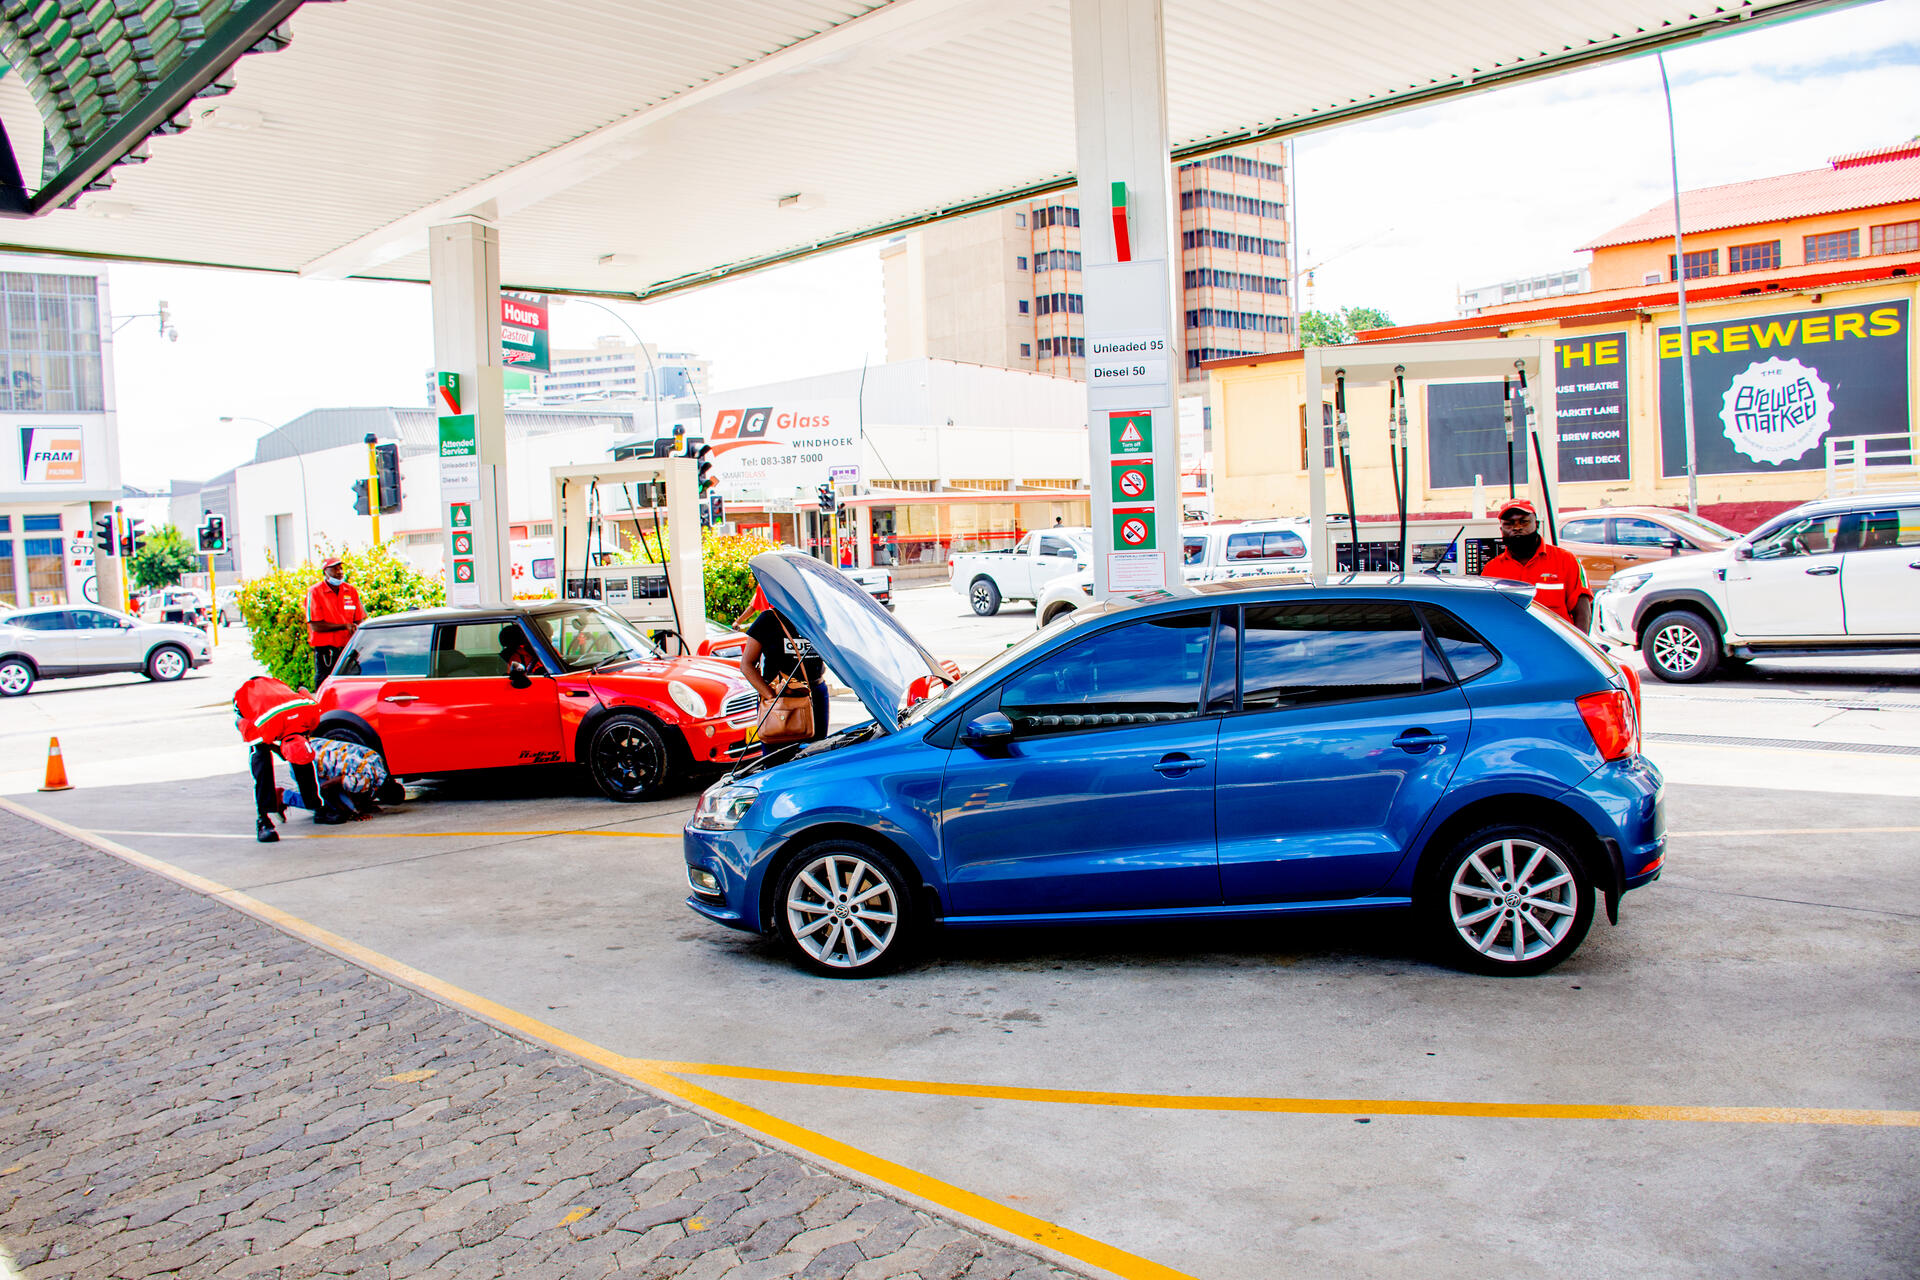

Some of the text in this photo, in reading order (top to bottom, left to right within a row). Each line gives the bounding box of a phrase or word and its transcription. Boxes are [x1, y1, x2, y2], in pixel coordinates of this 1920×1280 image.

[504, 303, 540, 326] Hours
[502, 328, 530, 344] Castrol
[1659, 308, 1901, 359] BREWERS
[1093, 340, 1164, 354] Unleaded 95
[1554, 339, 1619, 368] HE
[1094, 365, 1146, 378] Diesel 50
[448, 375, 455, 388] 5
[1577, 381, 1619, 392] THEATRE
[1593, 405, 1620, 415] LANE
[717, 411, 830, 435] PG Glass
[1562, 432, 1590, 442] BREW
[1591, 430, 1620, 440] ROOM
[441, 438, 474, 448] Attended
[792, 437, 854, 448] WINDHOEK
[34, 452, 73, 461] FRAM
[441, 447, 469, 456] Service
[741, 453, 823, 467] Tel: 083-387 5000
[1575, 455, 1621, 465] THE DECK
[786, 642, 811, 651] QUE
